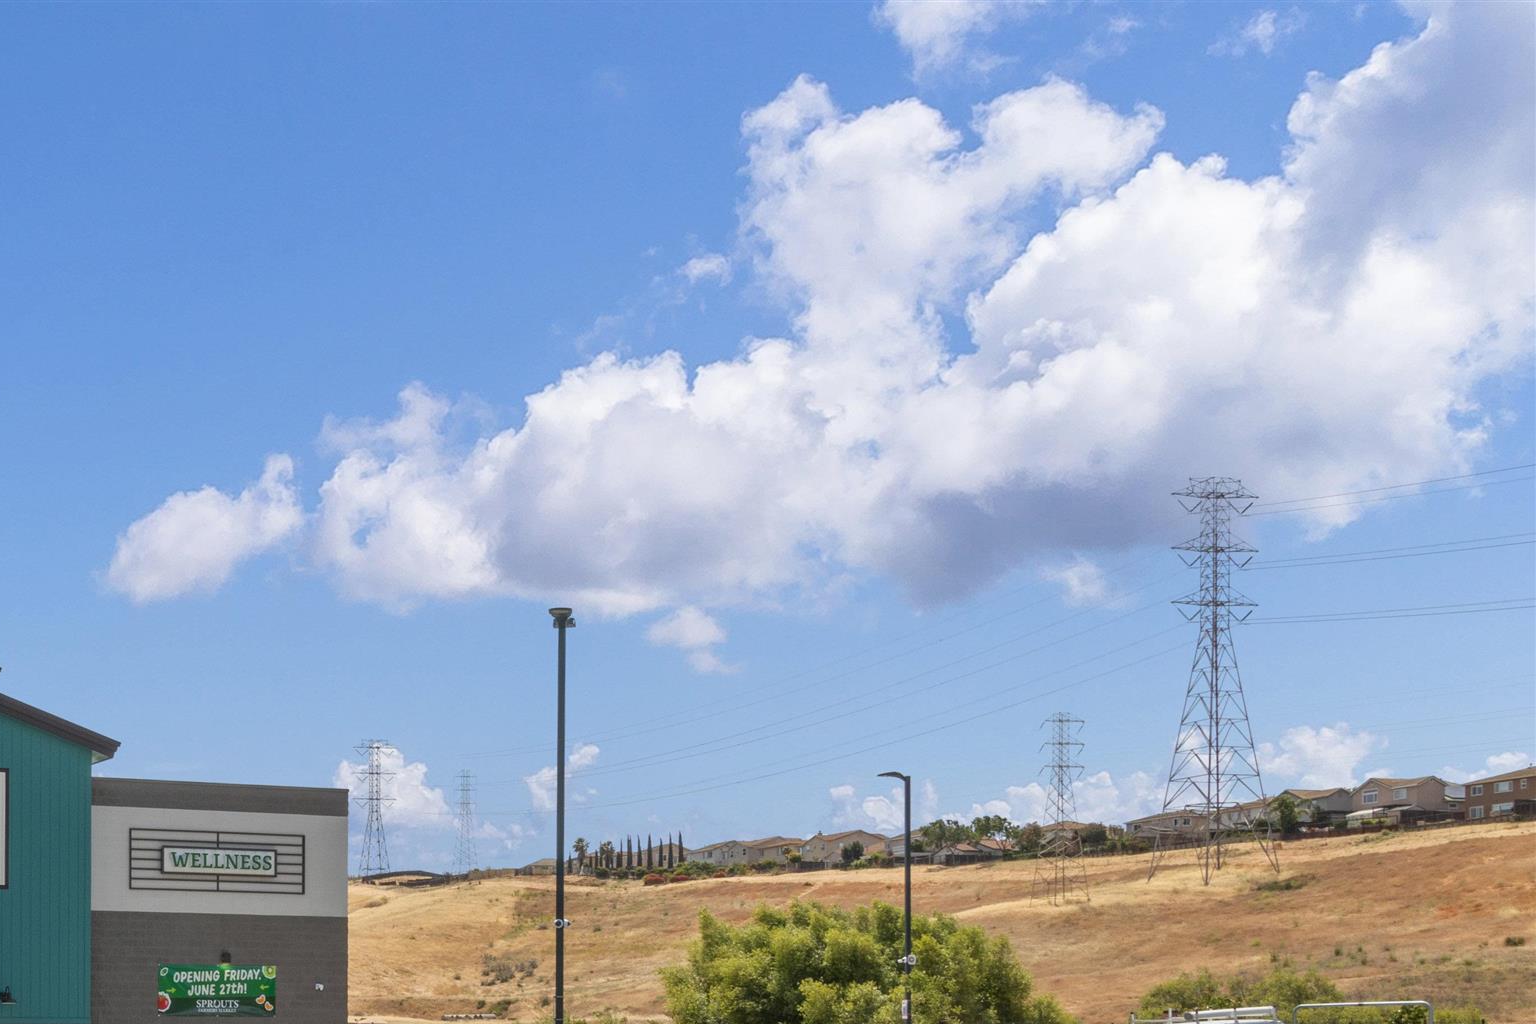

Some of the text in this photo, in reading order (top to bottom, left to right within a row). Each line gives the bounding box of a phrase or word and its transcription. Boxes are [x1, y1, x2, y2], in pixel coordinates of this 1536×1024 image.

[171, 851, 273, 871] WELLNESS
[173, 970, 220, 983] OPENING
[187, 982, 247, 996] JUNE 27th!
[196, 999, 240, 1009] SPROUTS
